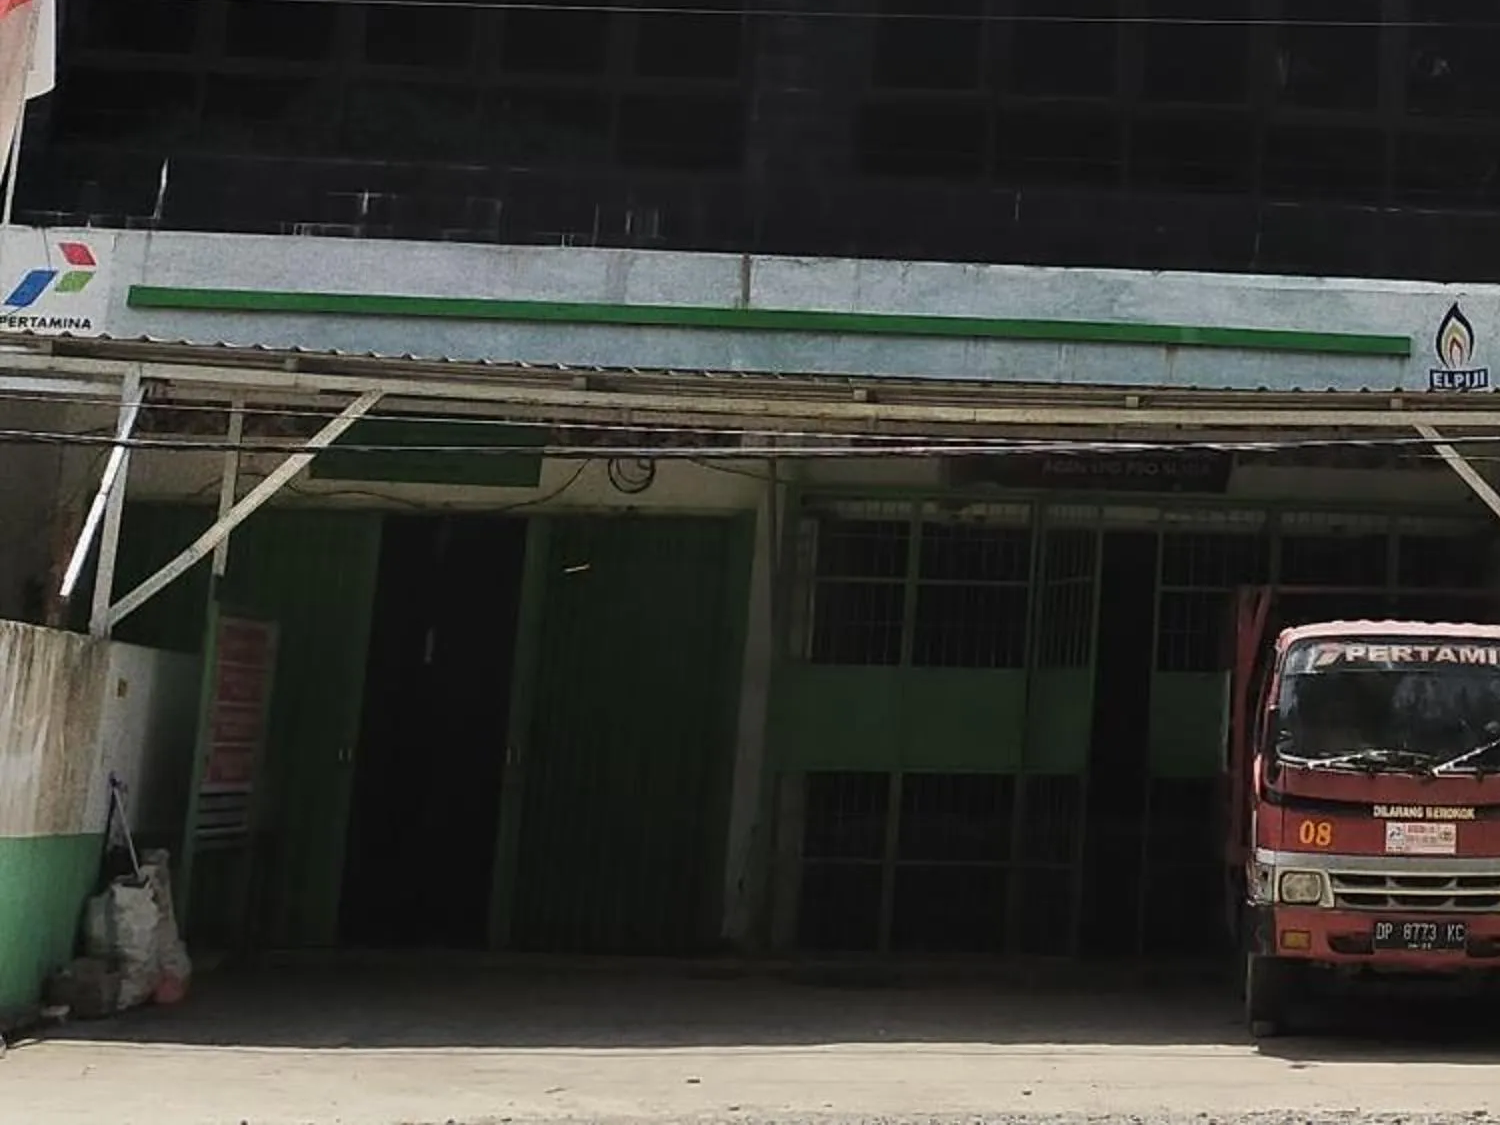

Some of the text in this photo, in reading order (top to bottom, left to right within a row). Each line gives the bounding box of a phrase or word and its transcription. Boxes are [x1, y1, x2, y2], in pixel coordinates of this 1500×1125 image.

[0, 315, 92, 329] PERTAMINA
[1432, 371, 1486, 388] ELPIJI
[1299, 820, 1332, 846] 08
[1376, 922, 1393, 940] DP
